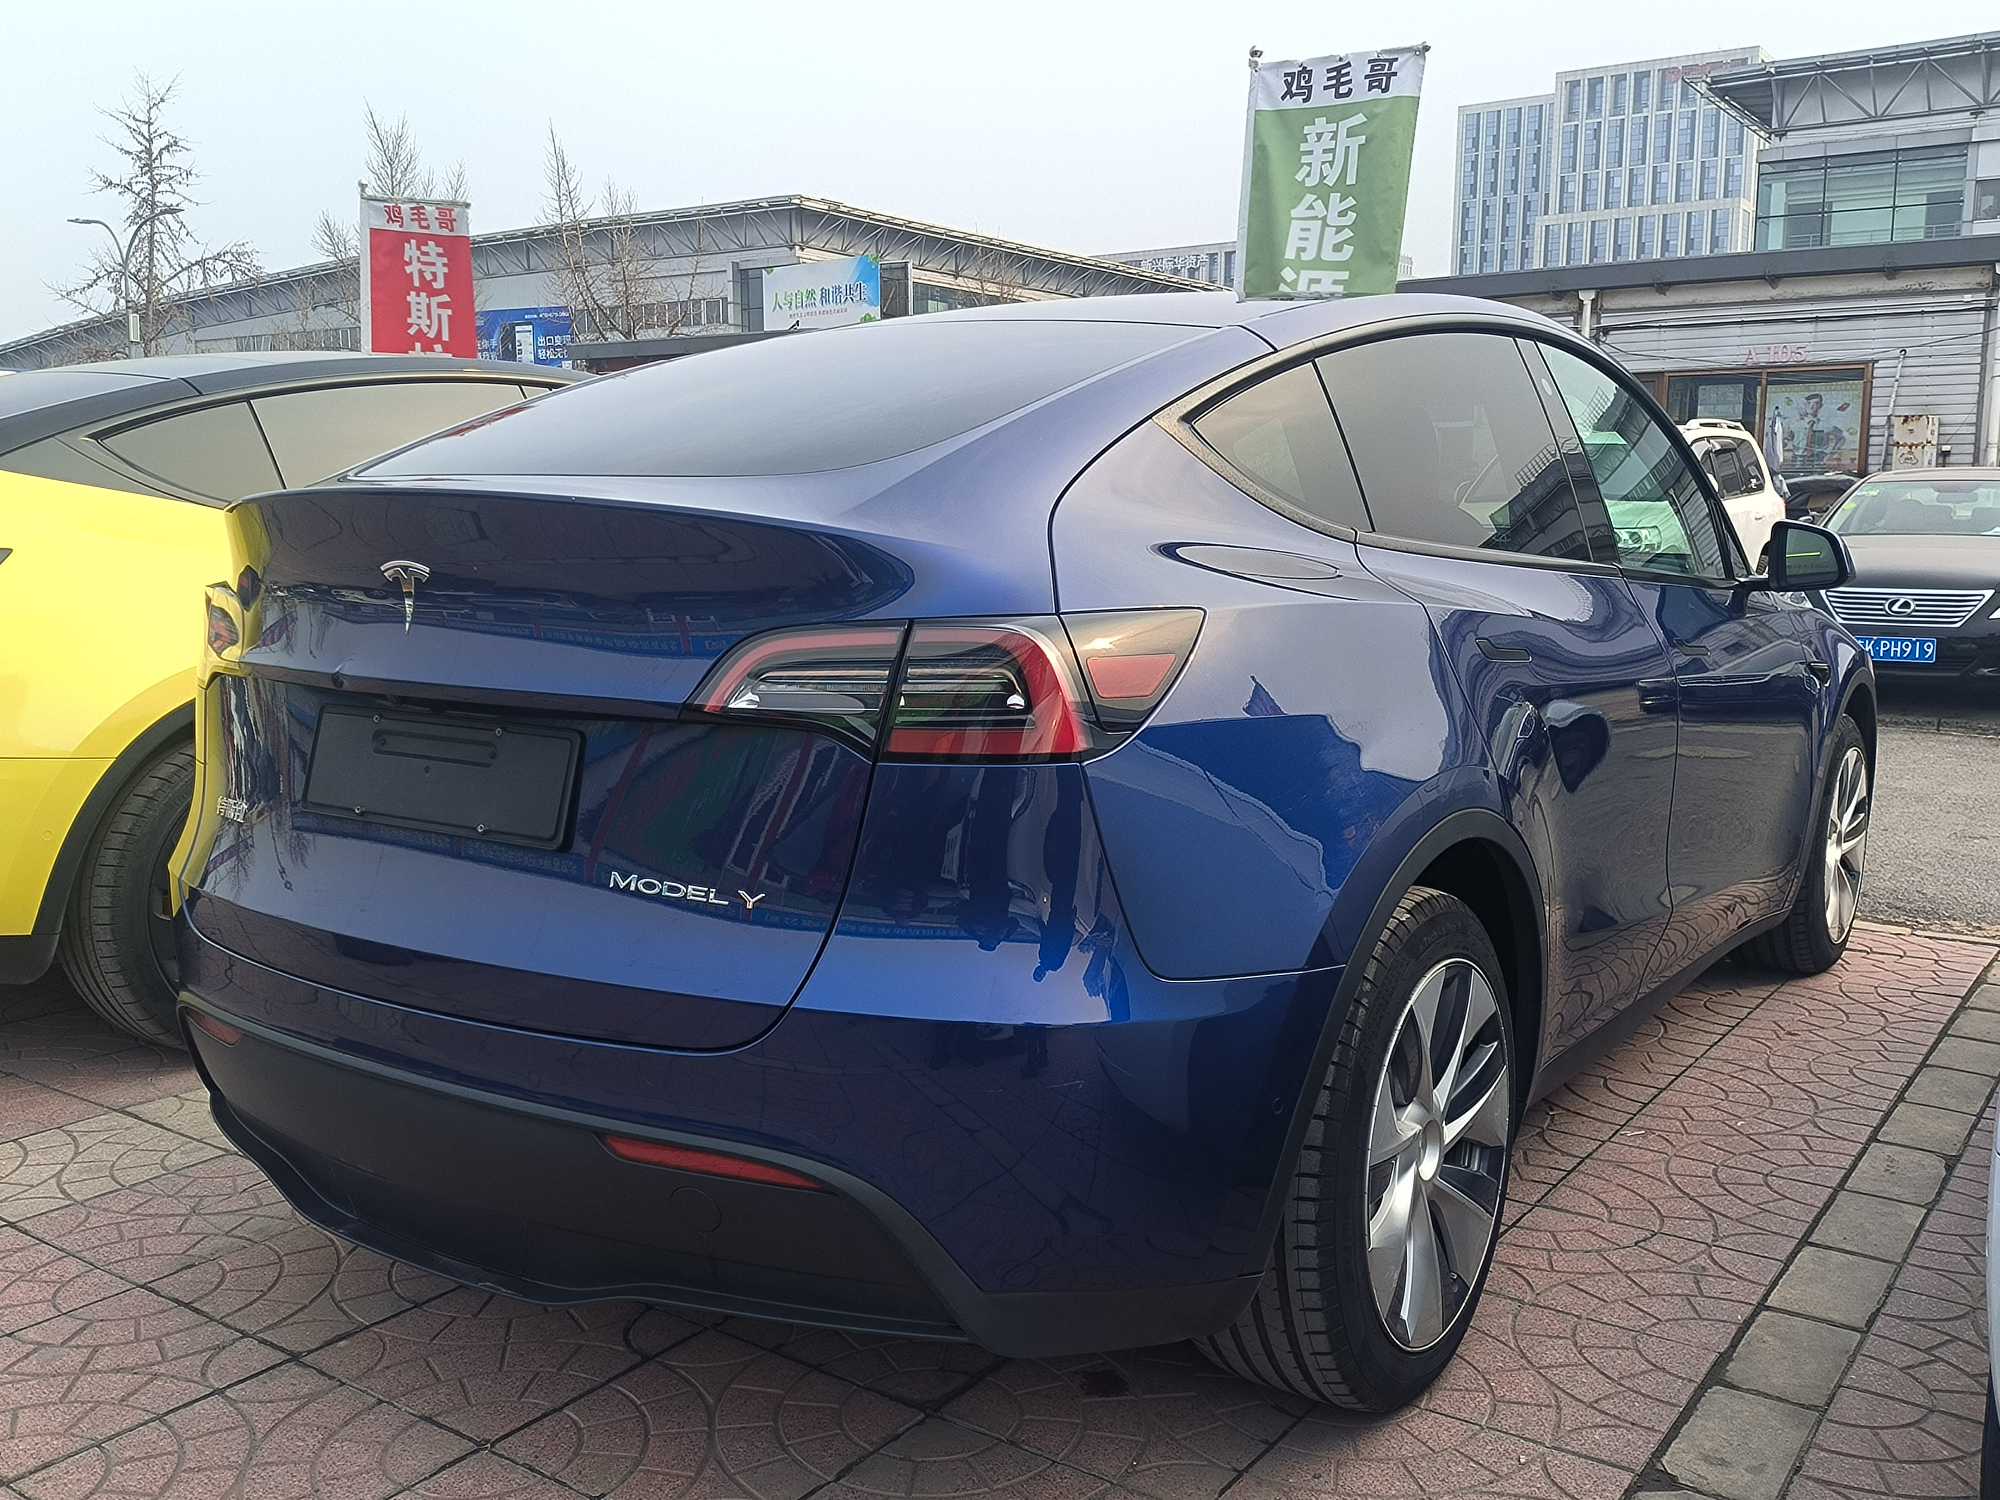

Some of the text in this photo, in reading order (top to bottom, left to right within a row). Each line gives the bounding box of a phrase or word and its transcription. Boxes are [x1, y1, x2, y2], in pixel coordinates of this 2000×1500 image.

[1280, 57, 1398, 103] 鸡毛哥
[383, 204, 457, 233] 鸡毛哥
[403, 239, 453, 358] 特斯
[772, 281, 867, 312] 人与自然 和谐共生
[609, 871, 766, 909] MODEL Y
